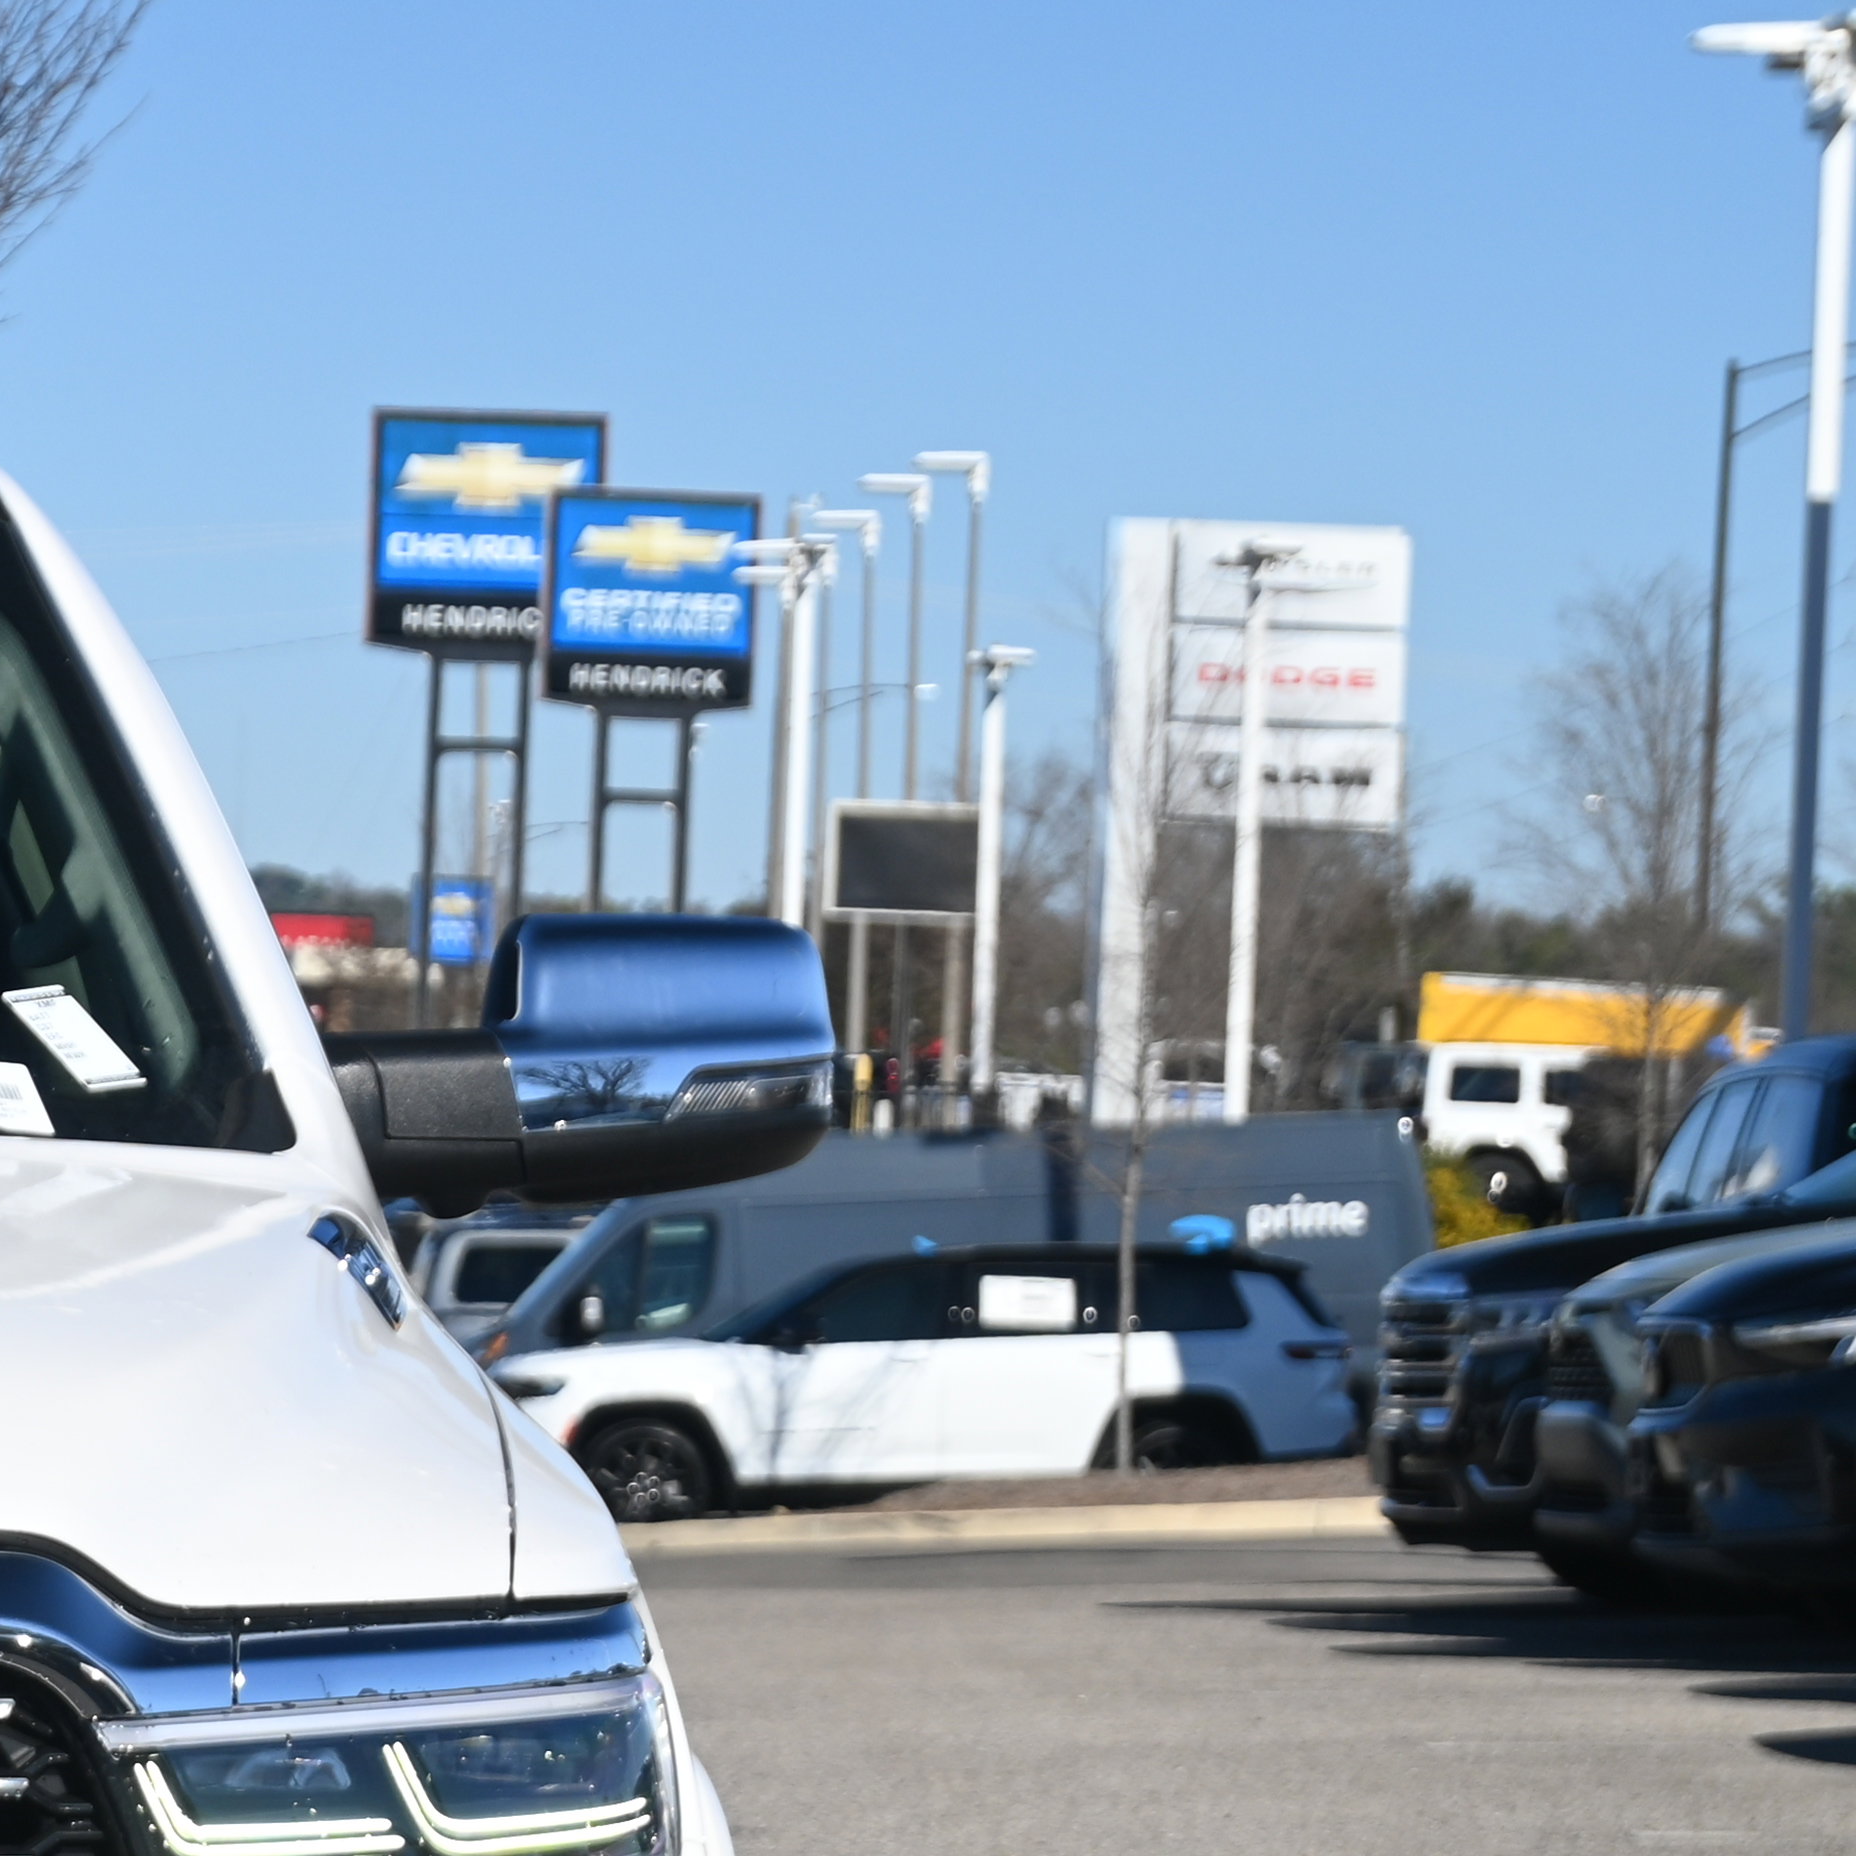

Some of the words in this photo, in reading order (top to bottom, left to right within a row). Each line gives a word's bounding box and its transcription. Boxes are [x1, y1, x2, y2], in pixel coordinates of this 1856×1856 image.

[386, 531, 543, 570] CHEVROL
[560, 587, 744, 616] CERTIFIED
[401, 603, 545, 637] HENDRIC
[567, 607, 735, 637] PRE-OWNED
[569, 661, 727, 697] HENDRICK
[1246, 1192, 1369, 1248] prime
